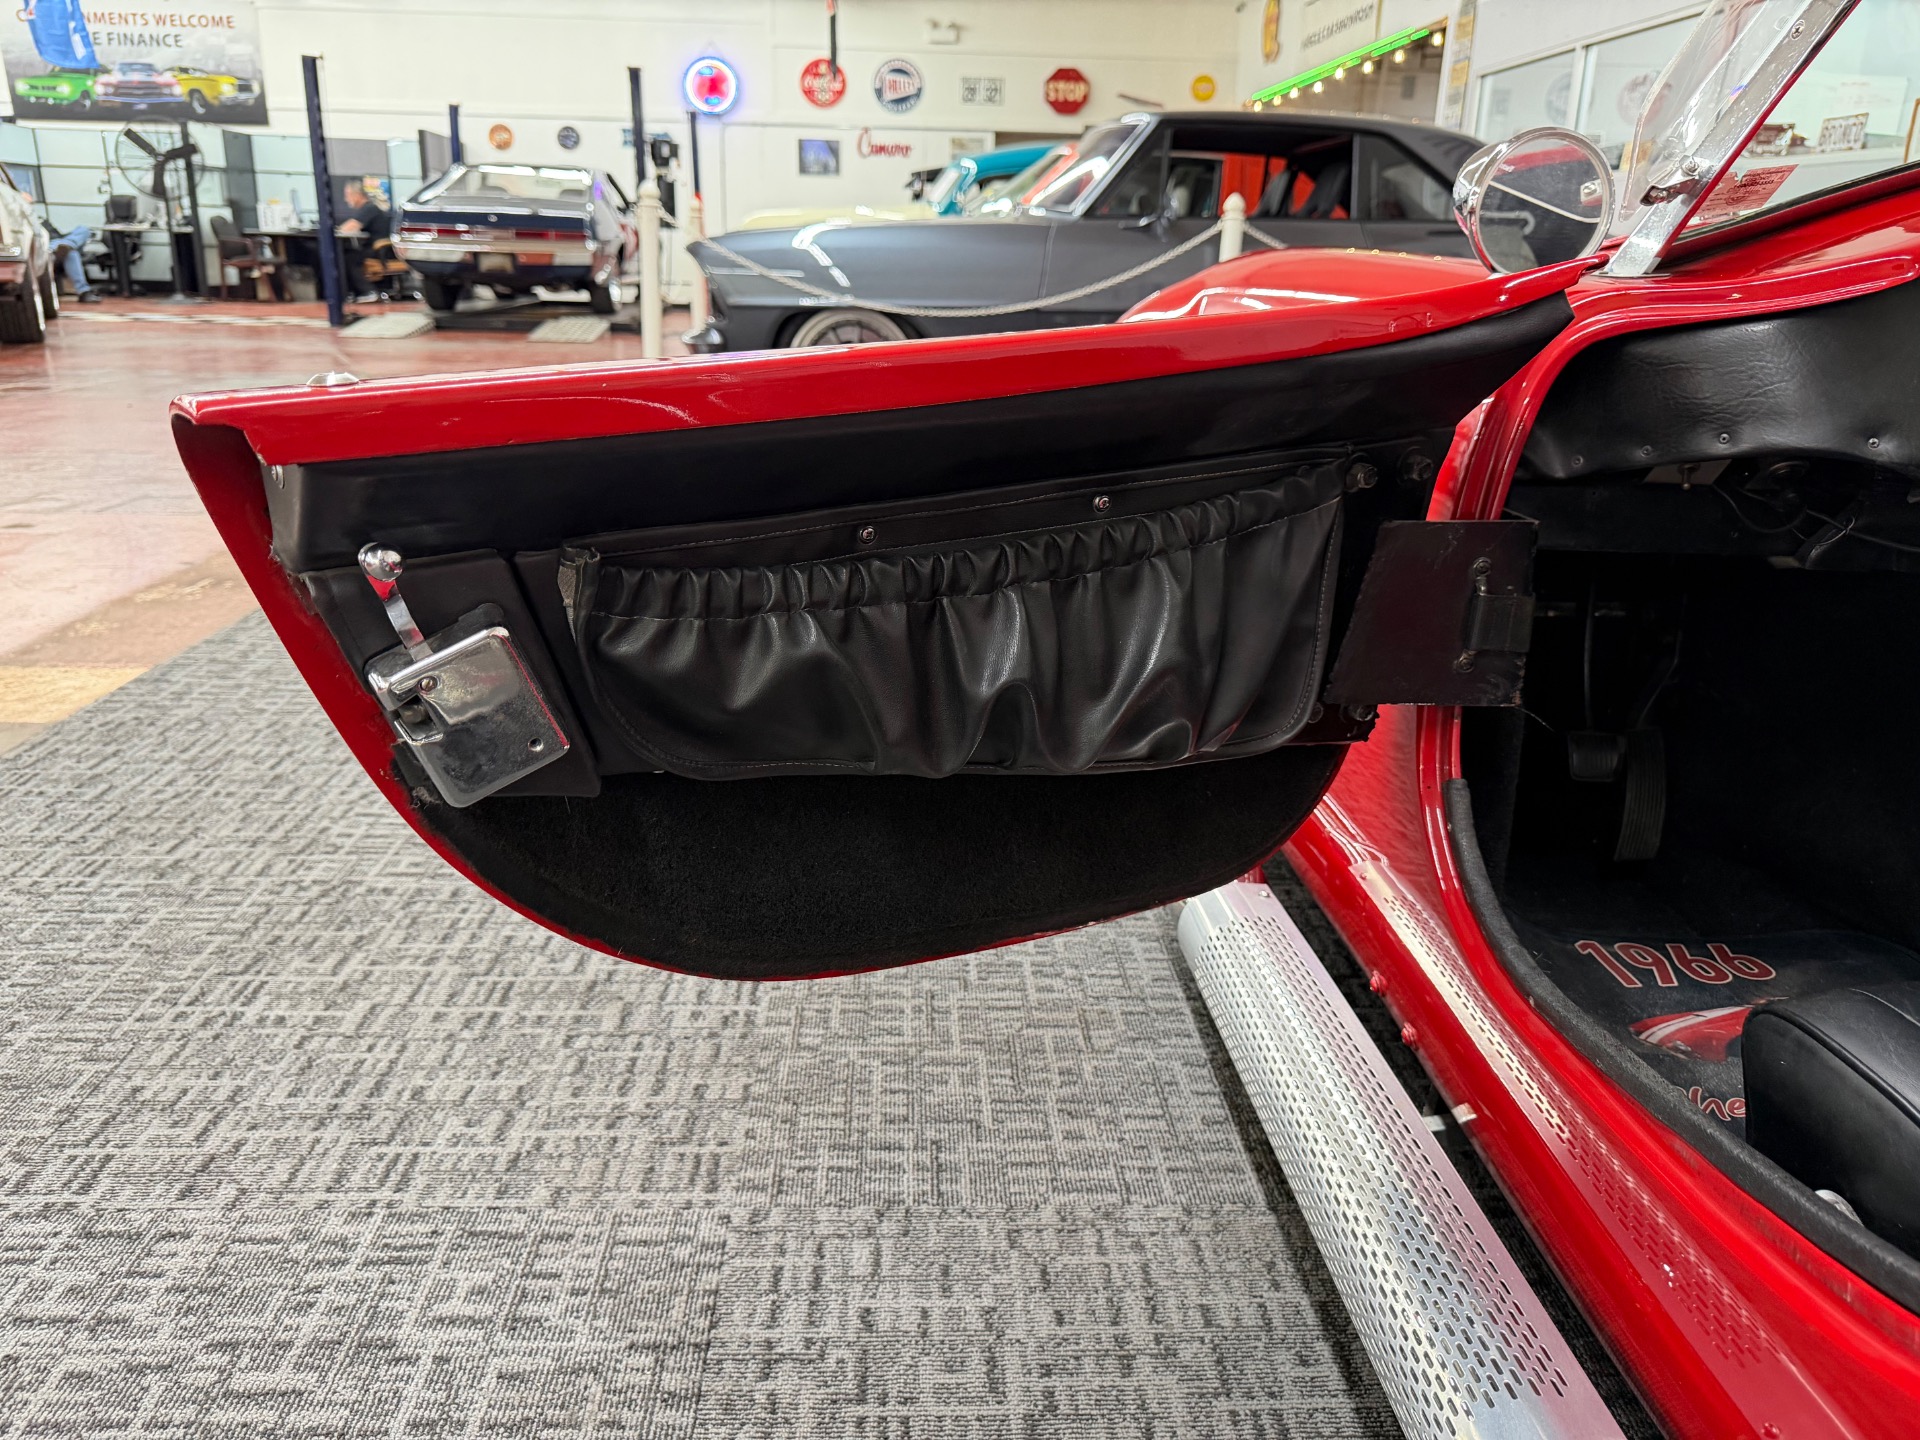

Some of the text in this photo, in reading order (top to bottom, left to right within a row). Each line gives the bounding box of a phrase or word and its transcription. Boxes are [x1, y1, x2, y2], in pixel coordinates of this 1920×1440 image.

[153, 13, 236, 29] WELCOME
[107, 32, 183, 48] FINANCE
[1046, 80, 1089, 103] STOP
[857, 127, 913, 159] Camaro
[1574, 940, 1777, 988] 1966
